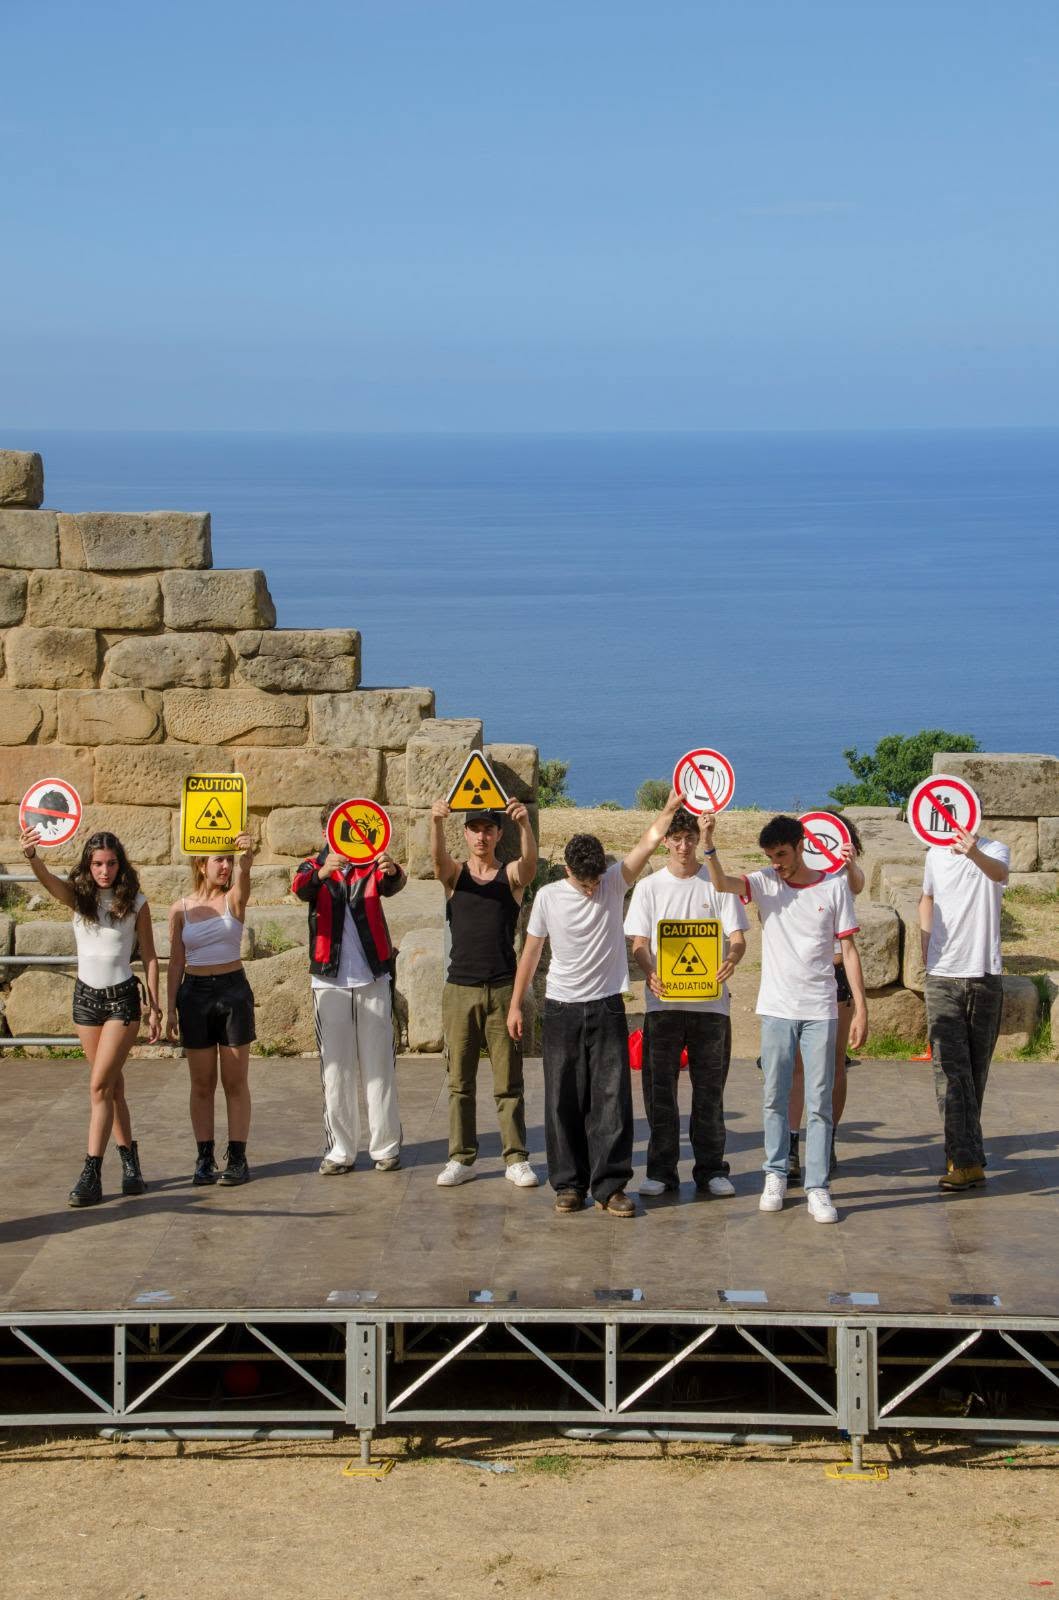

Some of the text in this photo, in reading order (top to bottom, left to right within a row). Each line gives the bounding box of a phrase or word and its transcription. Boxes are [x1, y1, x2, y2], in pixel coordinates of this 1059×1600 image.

[189, 779, 241, 790] CAUTION
[190, 836, 236, 844] RADIATION
[663, 925, 716, 936] CAUTION
[666, 982, 713, 990] RADIATION
